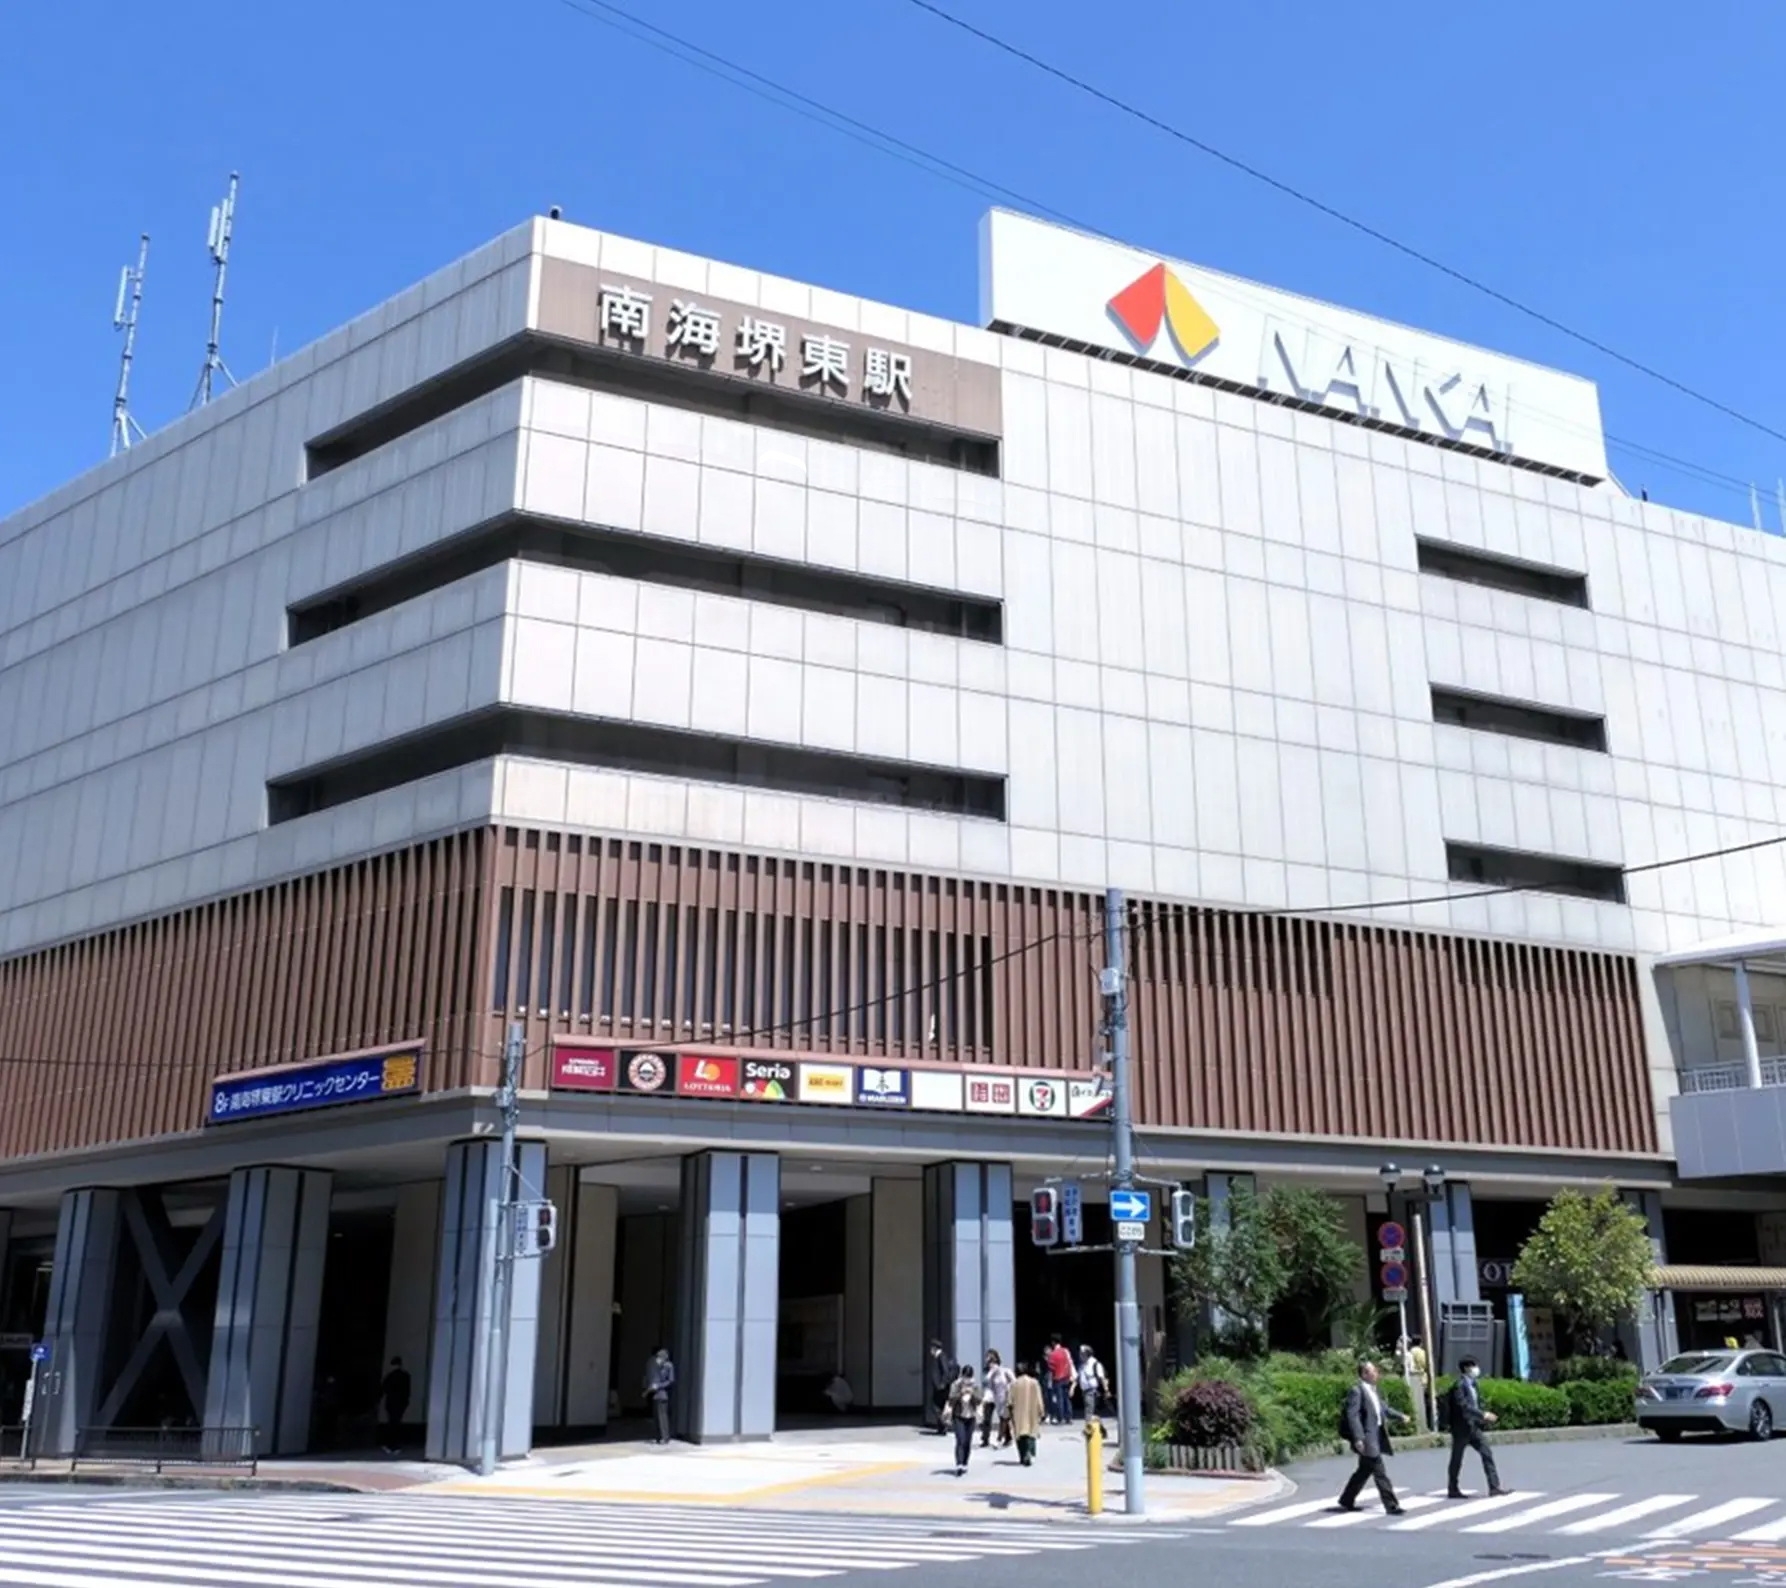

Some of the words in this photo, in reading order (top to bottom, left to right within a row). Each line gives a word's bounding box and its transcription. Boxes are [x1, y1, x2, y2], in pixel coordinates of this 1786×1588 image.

[600, 283, 914, 400] 南海堺東駅
[745, 1062, 792, 1080] Seria
[683, 1082, 732, 1093] LOTTERIA
